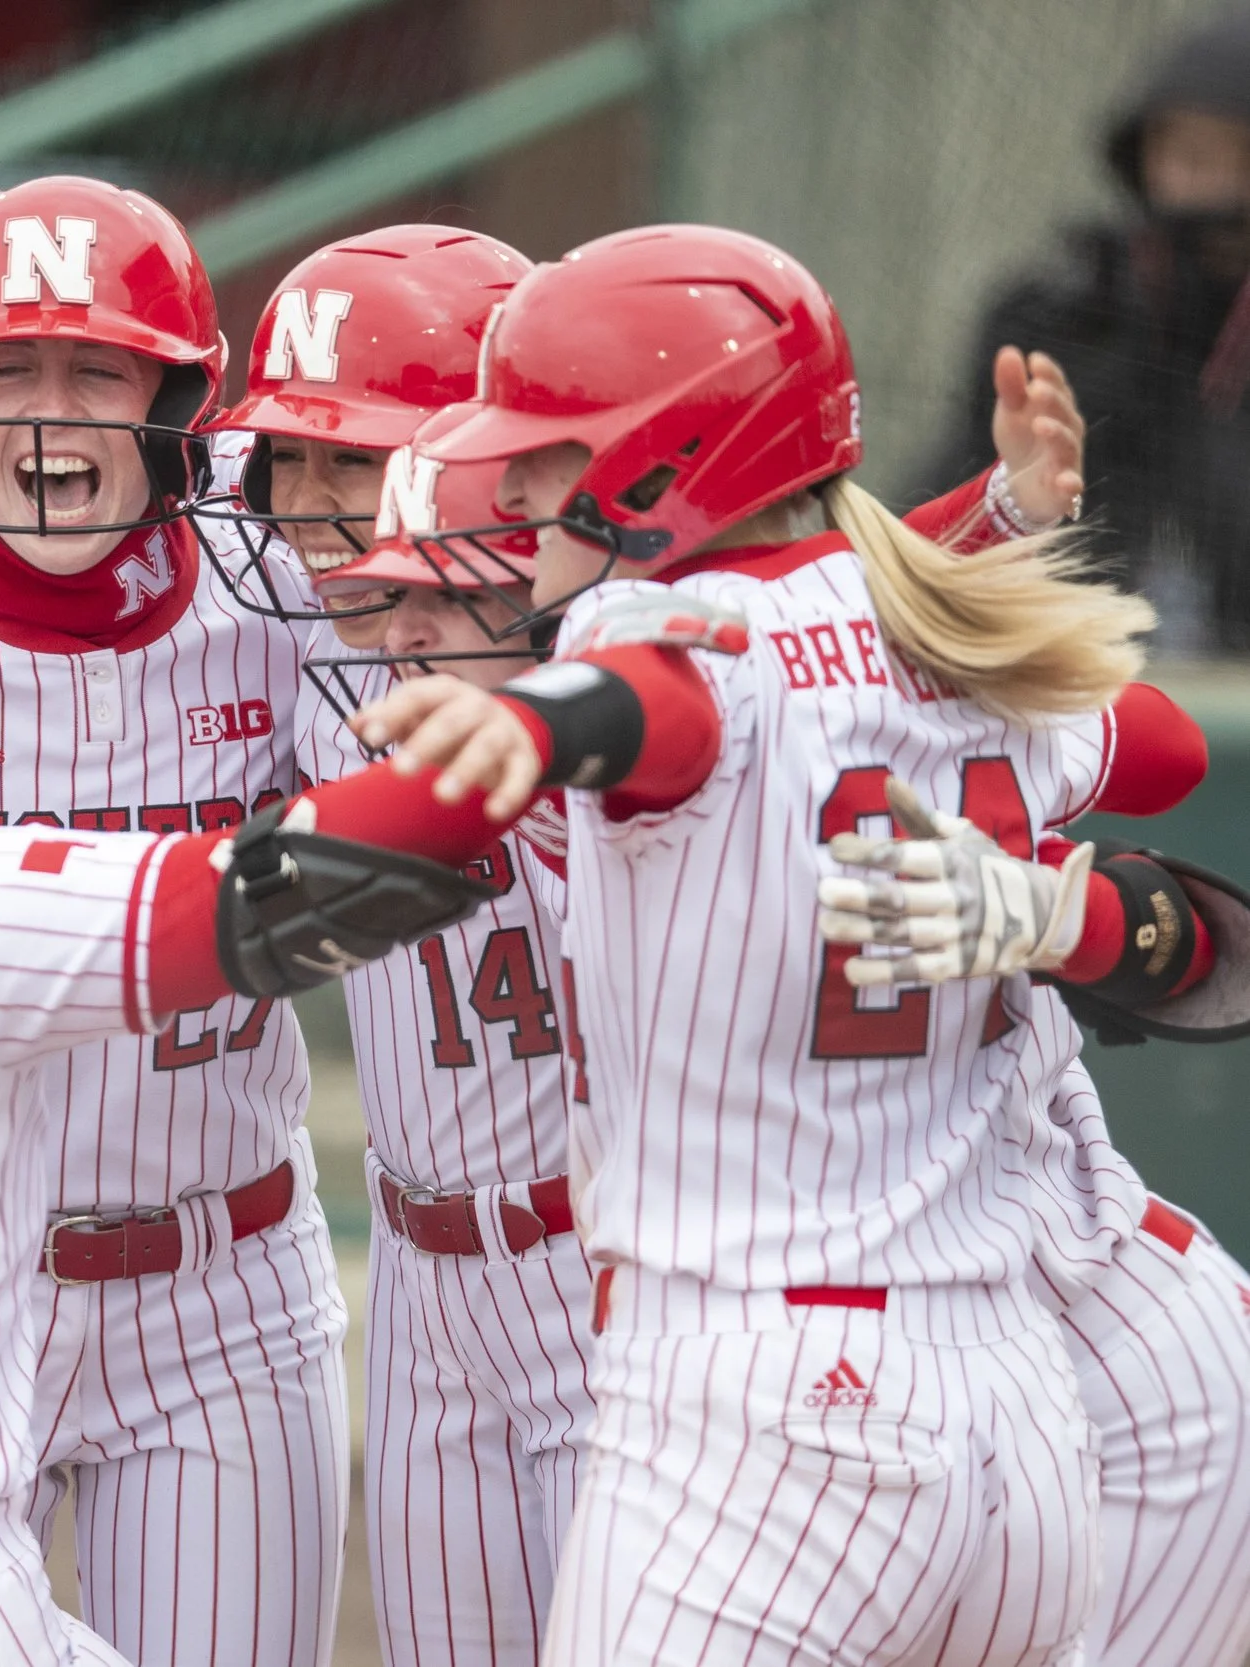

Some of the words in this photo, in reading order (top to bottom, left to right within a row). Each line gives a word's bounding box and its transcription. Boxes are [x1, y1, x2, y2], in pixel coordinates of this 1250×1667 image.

[1, 216, 97, 304] N
[262, 288, 354, 383] N
[374, 445, 446, 540] N
[112, 525, 175, 621] N
[417, 926, 564, 1069] 14
